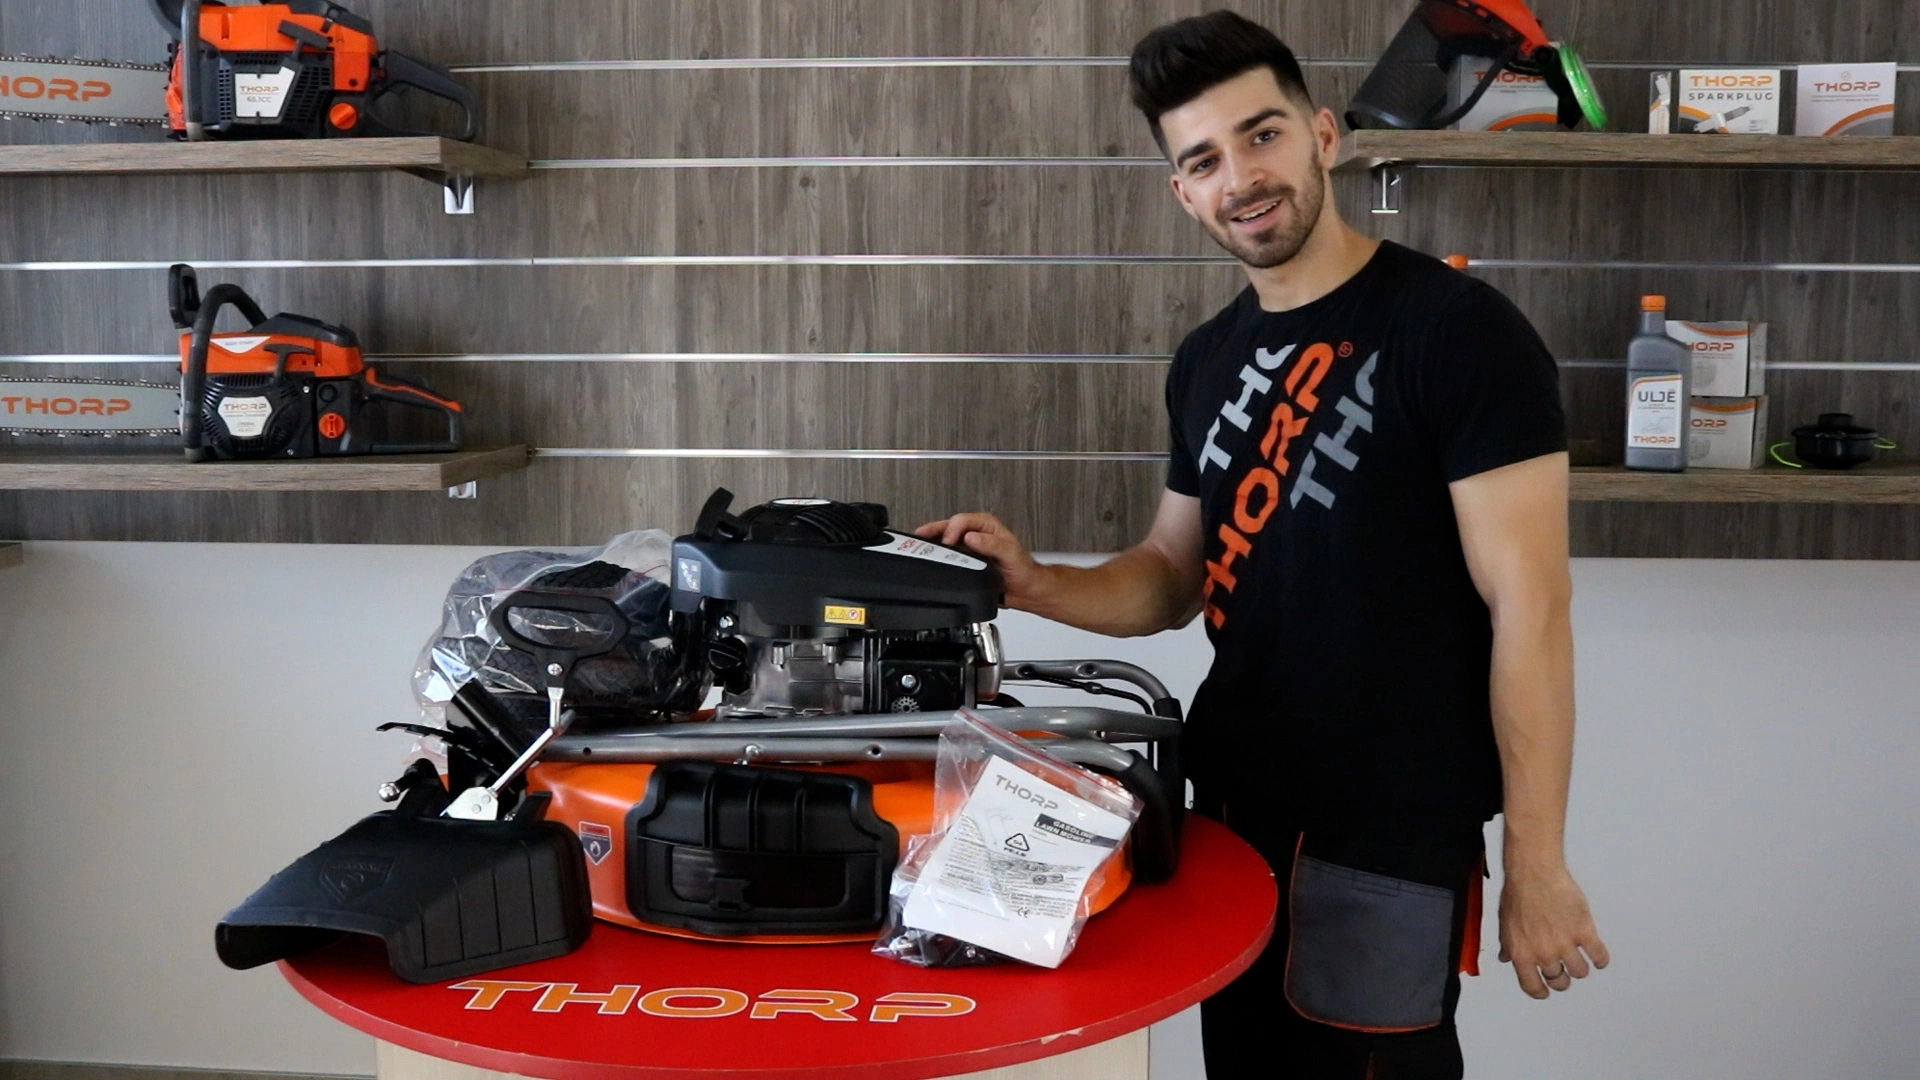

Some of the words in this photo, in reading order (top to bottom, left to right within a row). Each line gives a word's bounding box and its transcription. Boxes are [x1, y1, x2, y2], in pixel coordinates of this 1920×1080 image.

[1690, 75, 1773, 87] THORP
[1814, 82, 1881, 92] THORP
[1688, 92, 1773, 101] SPARKPLUG
[1638, 391, 1676, 402] ULJE
[2, 396, 131, 415] THORP
[1633, 435, 1676, 444] THORP
[995, 775, 1058, 810] THORP
[1036, 821, 1060, 836] LAWN
[1060, 829, 1092, 844] MOWER
[1053, 821, 1096, 839] GASOLINE
[448, 979, 977, 1023] THORP
